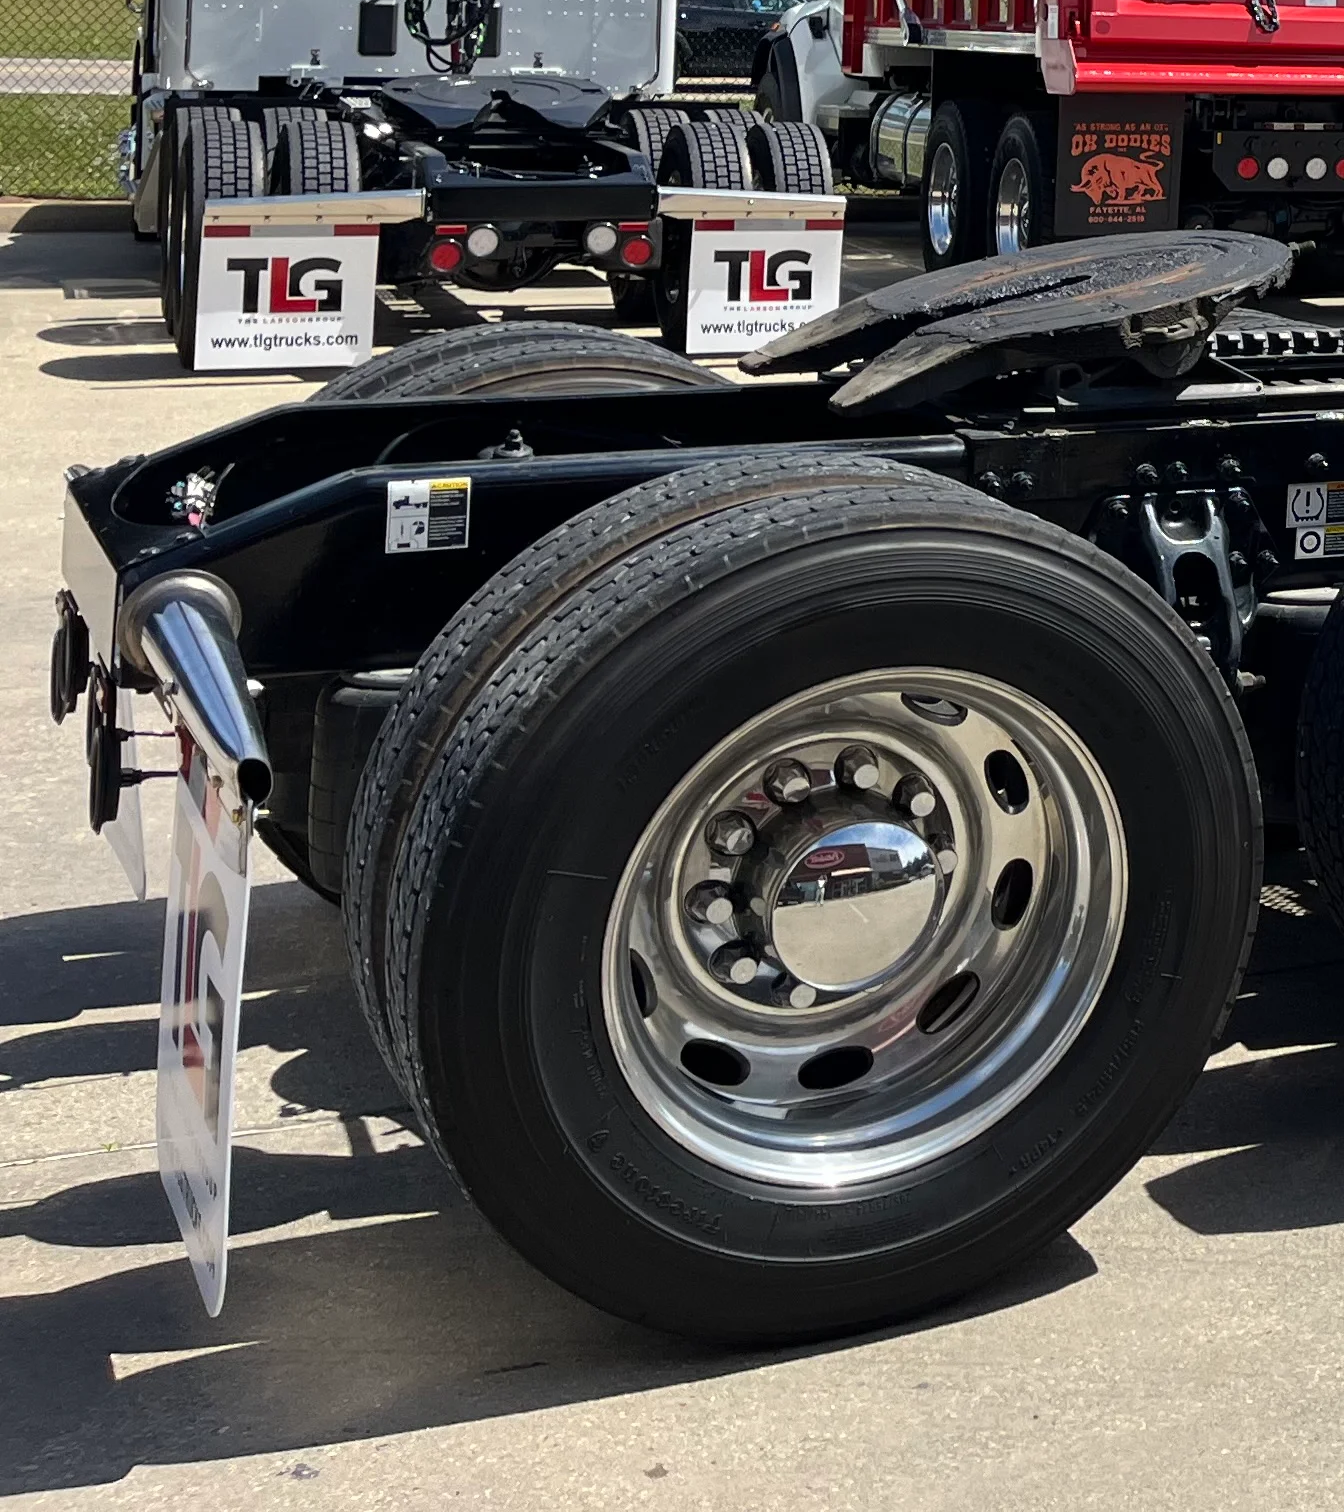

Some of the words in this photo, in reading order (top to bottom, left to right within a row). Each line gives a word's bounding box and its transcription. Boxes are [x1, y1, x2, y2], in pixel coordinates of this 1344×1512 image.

[1071, 134, 1098, 157] OX
[226, 257, 343, 314] TLG
[714, 249, 813, 302] TLG
[210, 333, 359, 351] www.tlgtrucks.com
